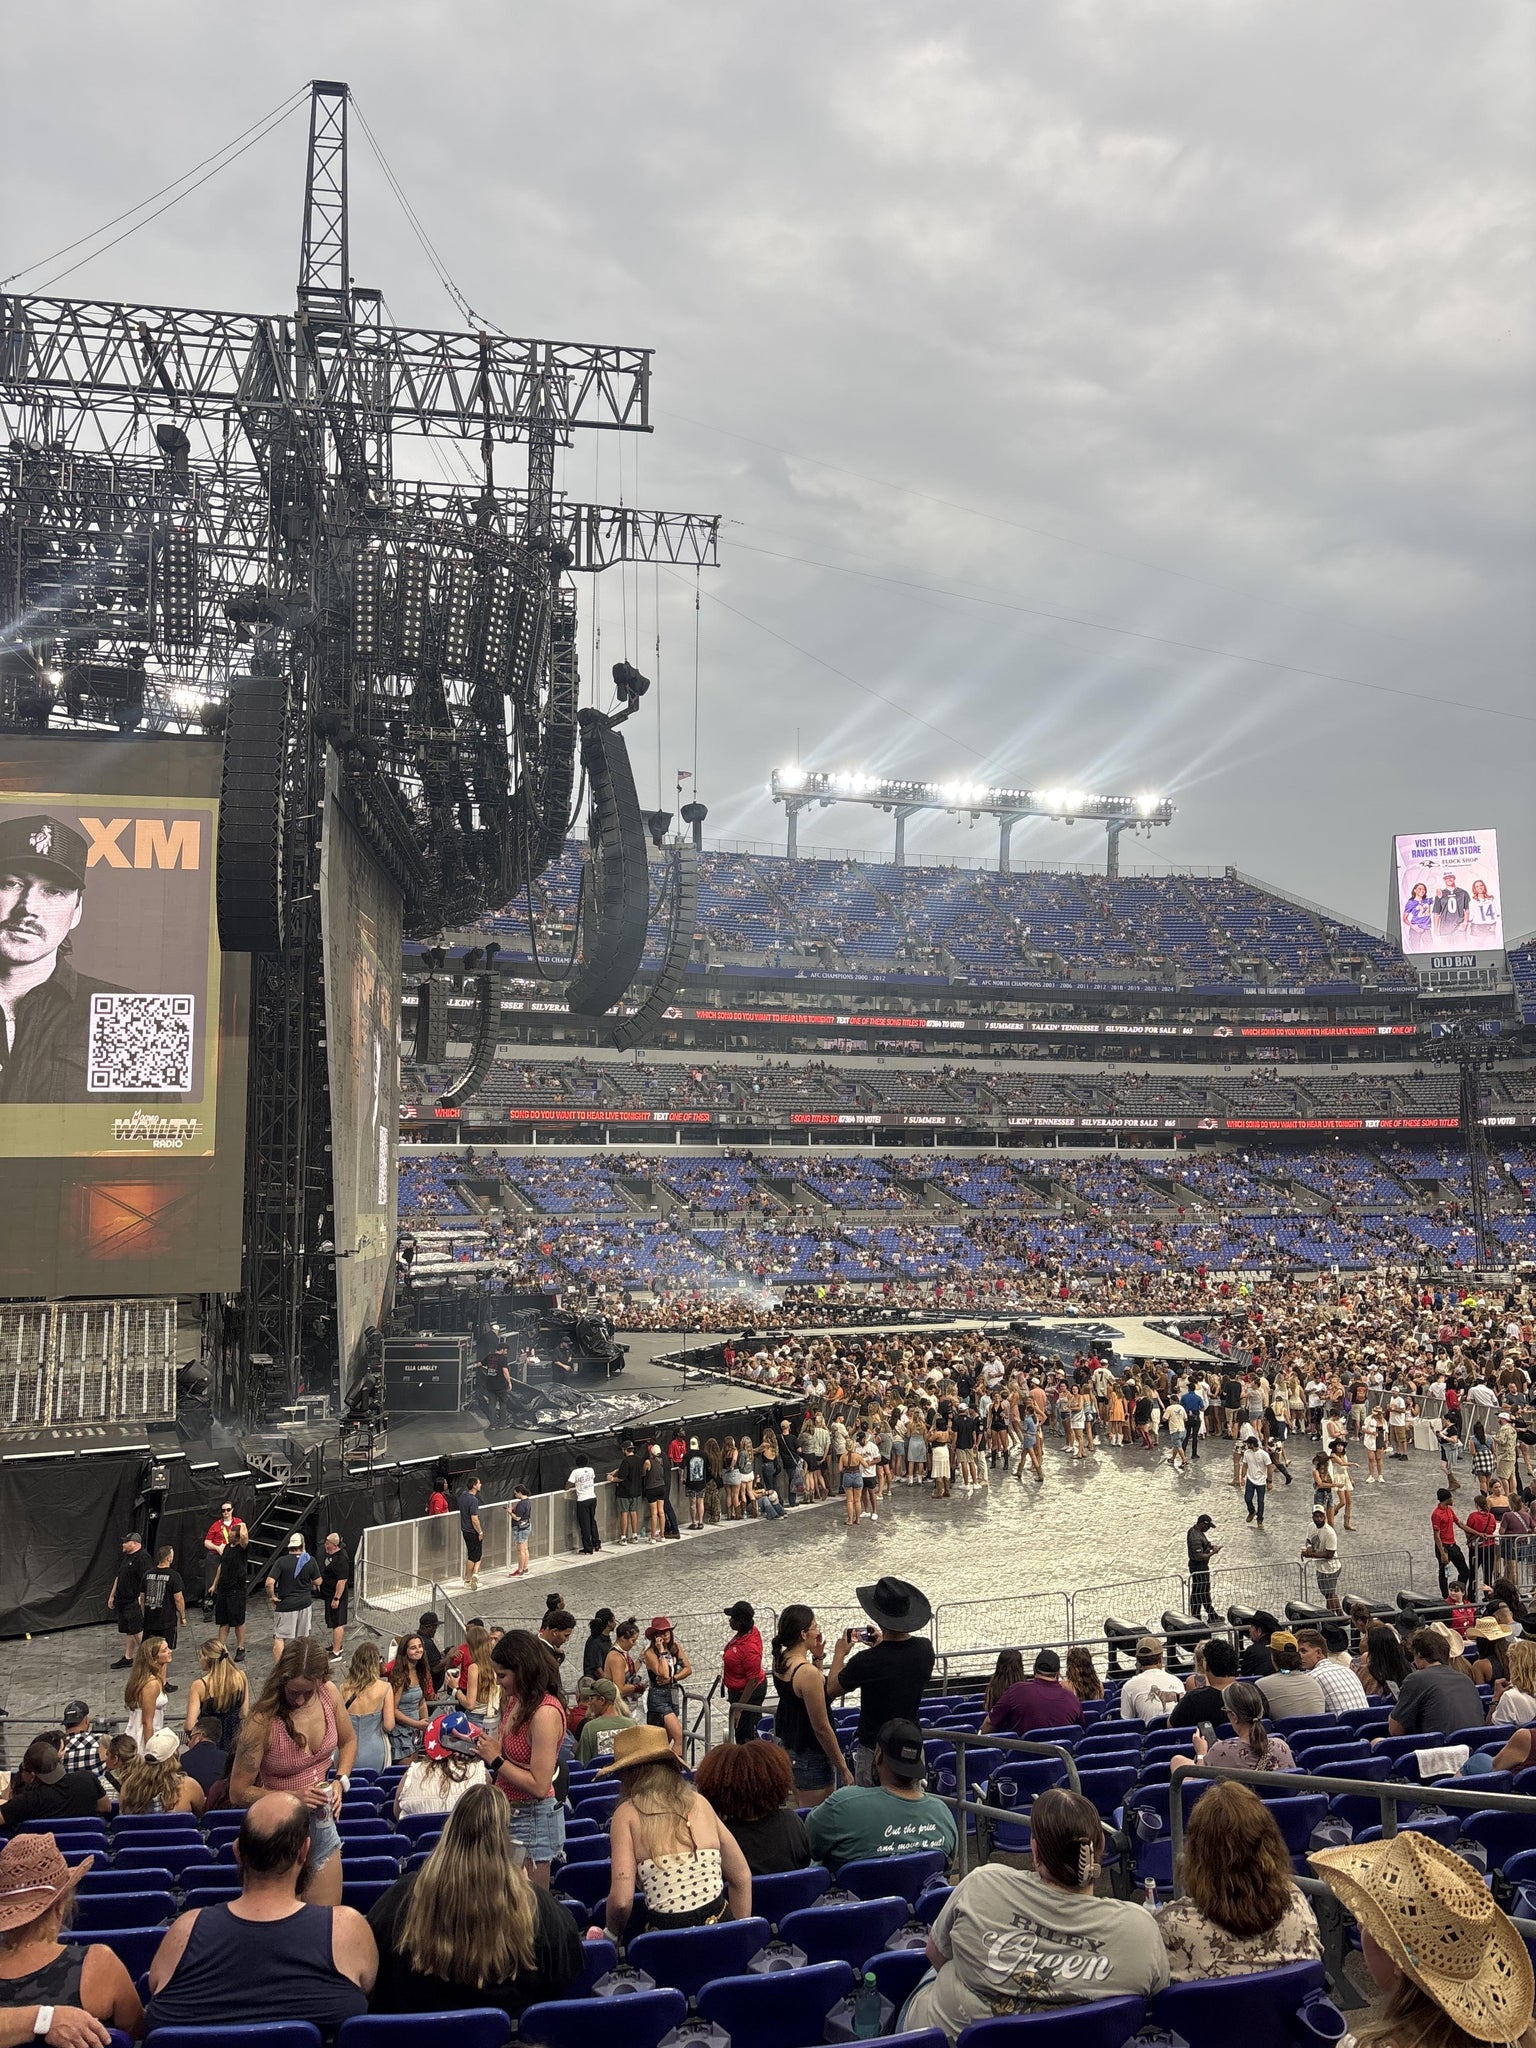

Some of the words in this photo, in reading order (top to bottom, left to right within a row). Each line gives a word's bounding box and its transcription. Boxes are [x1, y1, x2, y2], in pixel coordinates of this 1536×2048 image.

[78, 817, 200, 870] XM
[1415, 839, 1433, 848] VISIT
[1434, 838, 1447, 847] THE
[1448, 835, 1477, 846] OFFICIAL
[1412, 848, 1438, 858] RAVENS
[1439, 847, 1458, 856] TEAM
[1460, 845, 1481, 855] STORE
[1447, 897, 1457, 914] 0
[1479, 903, 1495, 921] 14
[527, 955, 550, 963] WRLD
[1434, 957, 1453, 968] OLD
[1455, 956, 1474, 967] BAY
[435, 1109, 461, 1118] WHICH
[510, 1110, 529, 1119] SONG
[530, 1110, 540, 1119] DO
[541, 1110, 555, 1119] YOU
[556, 1111, 576, 1120] WANT
[577, 1111, 586, 1120] TO
[587, 1111, 604, 1120] HEAR
[605, 1111, 619, 1120] LIVE
[620, 1112, 651, 1121] TONIGHT?
[653, 1112, 669, 1121] TEXT
[669, 1112, 682, 1121] ONE
[683, 1112, 692, 1121] OF
[795, 1115, 811, 1123] SONG
[811, 1115, 829, 1123] TITLES
[830, 1115, 838, 1123] TO
[855, 1115, 863, 1124] TO
[1034, 1118, 1075, 1126] TENNESSEE
[1226, 1120, 1245, 1128] WHICH
[1246, 1120, 1260, 1128] SONG
[1261, 1120, 1268, 1128] DO
[1268, 1120, 1280, 1128] YOU
[1280, 1120, 1297, 1128] WANT
[1298, 1120, 1306, 1128] TO
[1306, 1120, 1321, 1128] HEAR
[1322, 1120, 1334, 1128] LIVE
[1335, 1119, 1363, 1127] TONIGHT?
[1365, 1119, 1379, 1127] TEXT
[1380, 1119, 1392, 1127] ONE
[1393, 1119, 1402, 1127] OF
[1402, 1119, 1421, 1127] THESE
[1421, 1119, 1438, 1127] SONG
[1439, 1119, 1459, 1127] TITLES
[1488, 1117, 1497, 1125] TO
[113, 1118, 198, 1141] WALLEN
[153, 1140, 184, 1148] RADIO
[1098, 1371, 1104, 1382] 7
[884, 1824, 902, 1838] Cut
[903, 1823, 917, 1834] the
[918, 1823, 937, 1835] price
[876, 1842, 895, 1852] and
[897, 1842, 920, 1850] move
[922, 1839, 929, 1847] it
[930, 1835, 946, 1847] out!
[1009, 1912, 1106, 1955] RILEY
[981, 1930, 1115, 1985] Green
